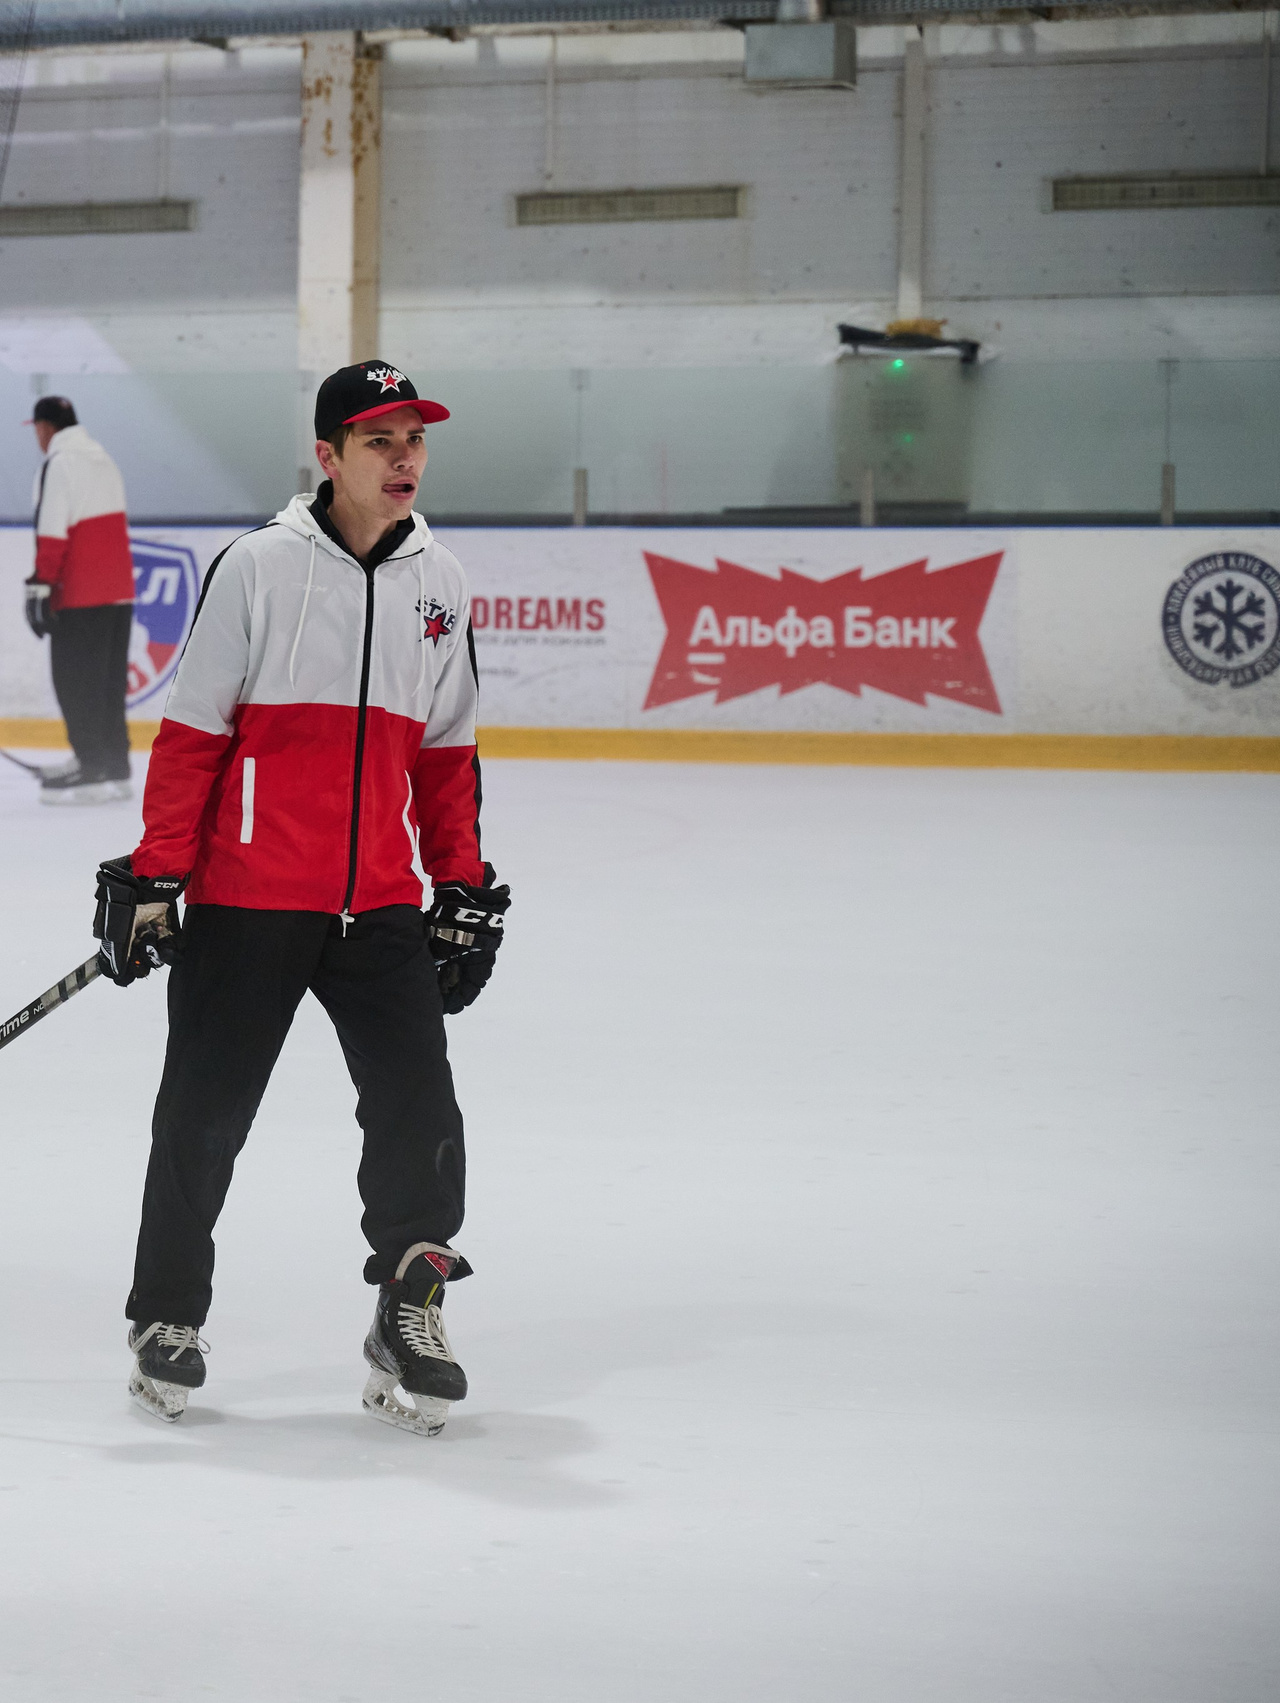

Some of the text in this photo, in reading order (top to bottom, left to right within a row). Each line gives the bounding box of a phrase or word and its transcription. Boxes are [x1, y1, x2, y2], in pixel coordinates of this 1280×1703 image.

[471, 596, 606, 631] DREAMS
[688, 605, 958, 658] Альфа Банк
